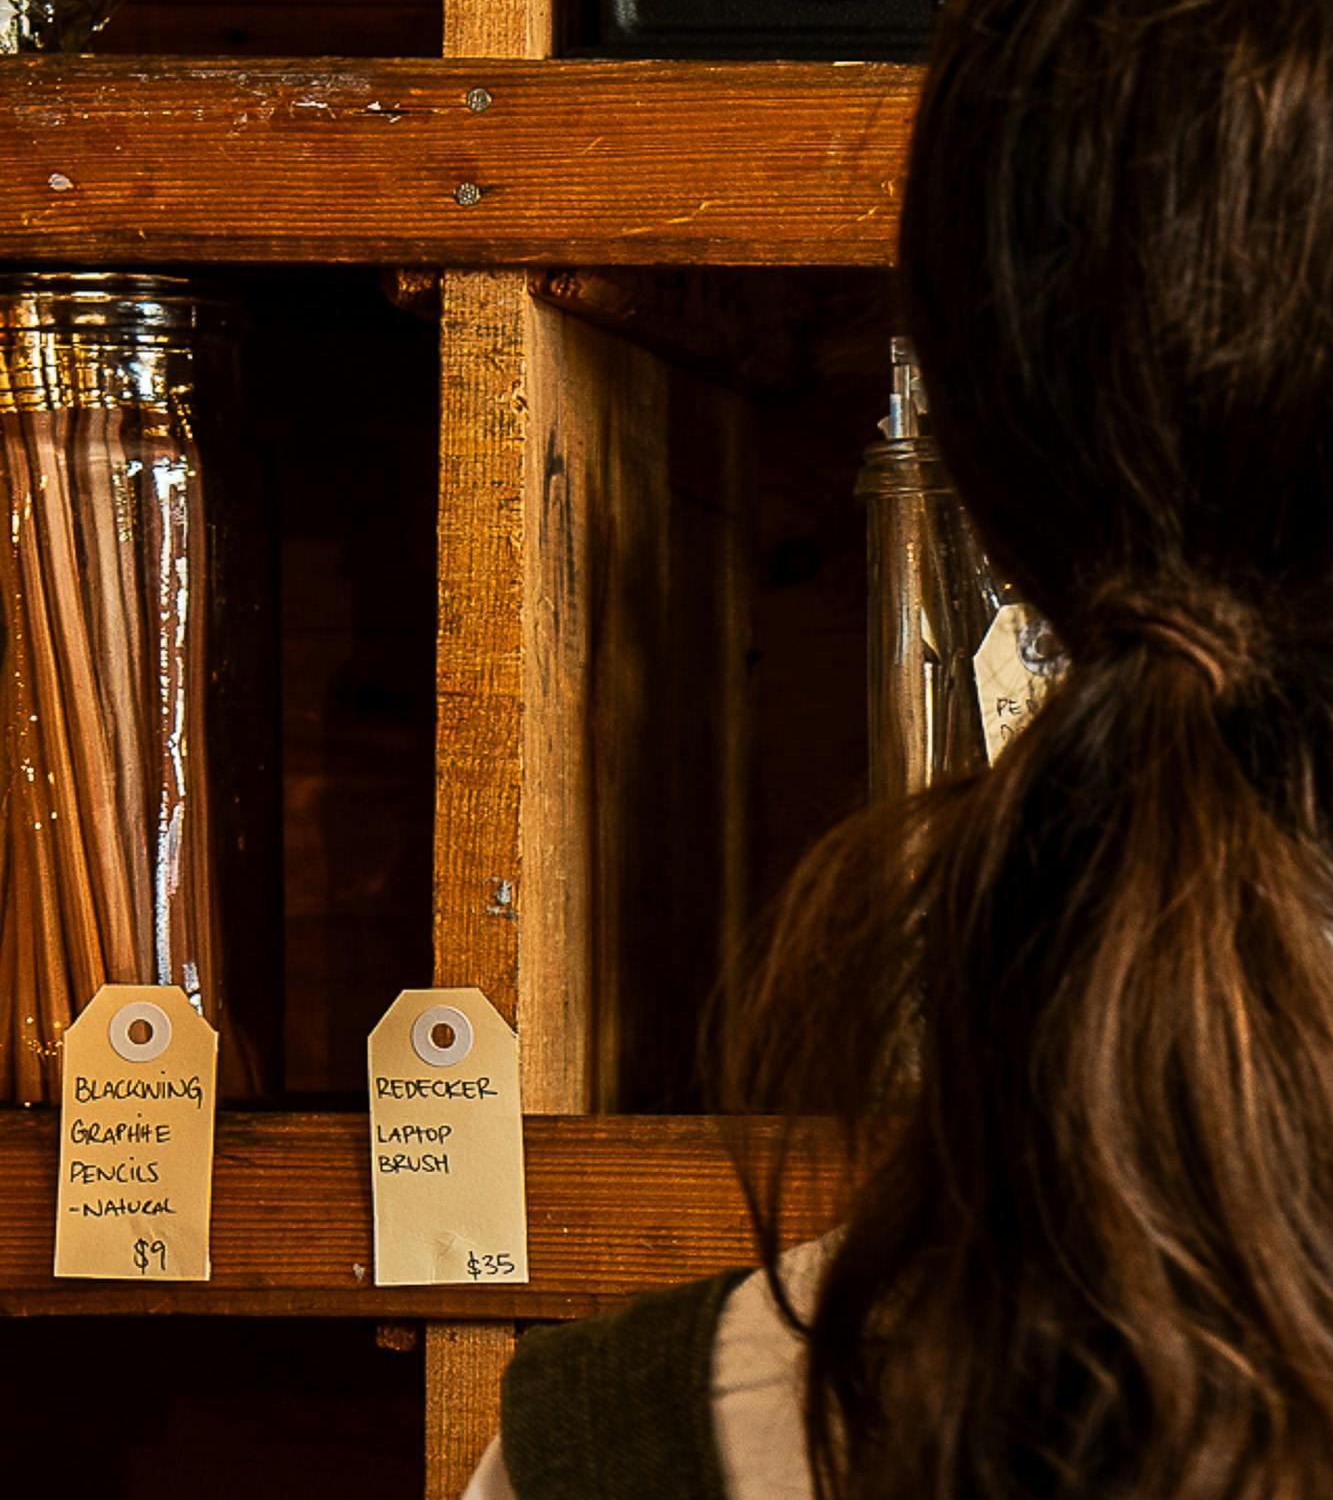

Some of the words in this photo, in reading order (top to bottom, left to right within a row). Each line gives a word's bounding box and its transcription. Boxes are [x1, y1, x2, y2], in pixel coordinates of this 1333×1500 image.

[75, 1071, 203, 1109] BLACKWING
[376, 1077, 498, 1100] REDECKER
[71, 1113, 172, 1145] GRAPHITE
[377, 1124, 452, 1145] LAPTOP
[70, 1156, 160, 1184] PENCILS
[379, 1154, 450, 1174] BRUSH
[133, 1238, 167, 1275] $9
[467, 1251, 515, 1280] $35
